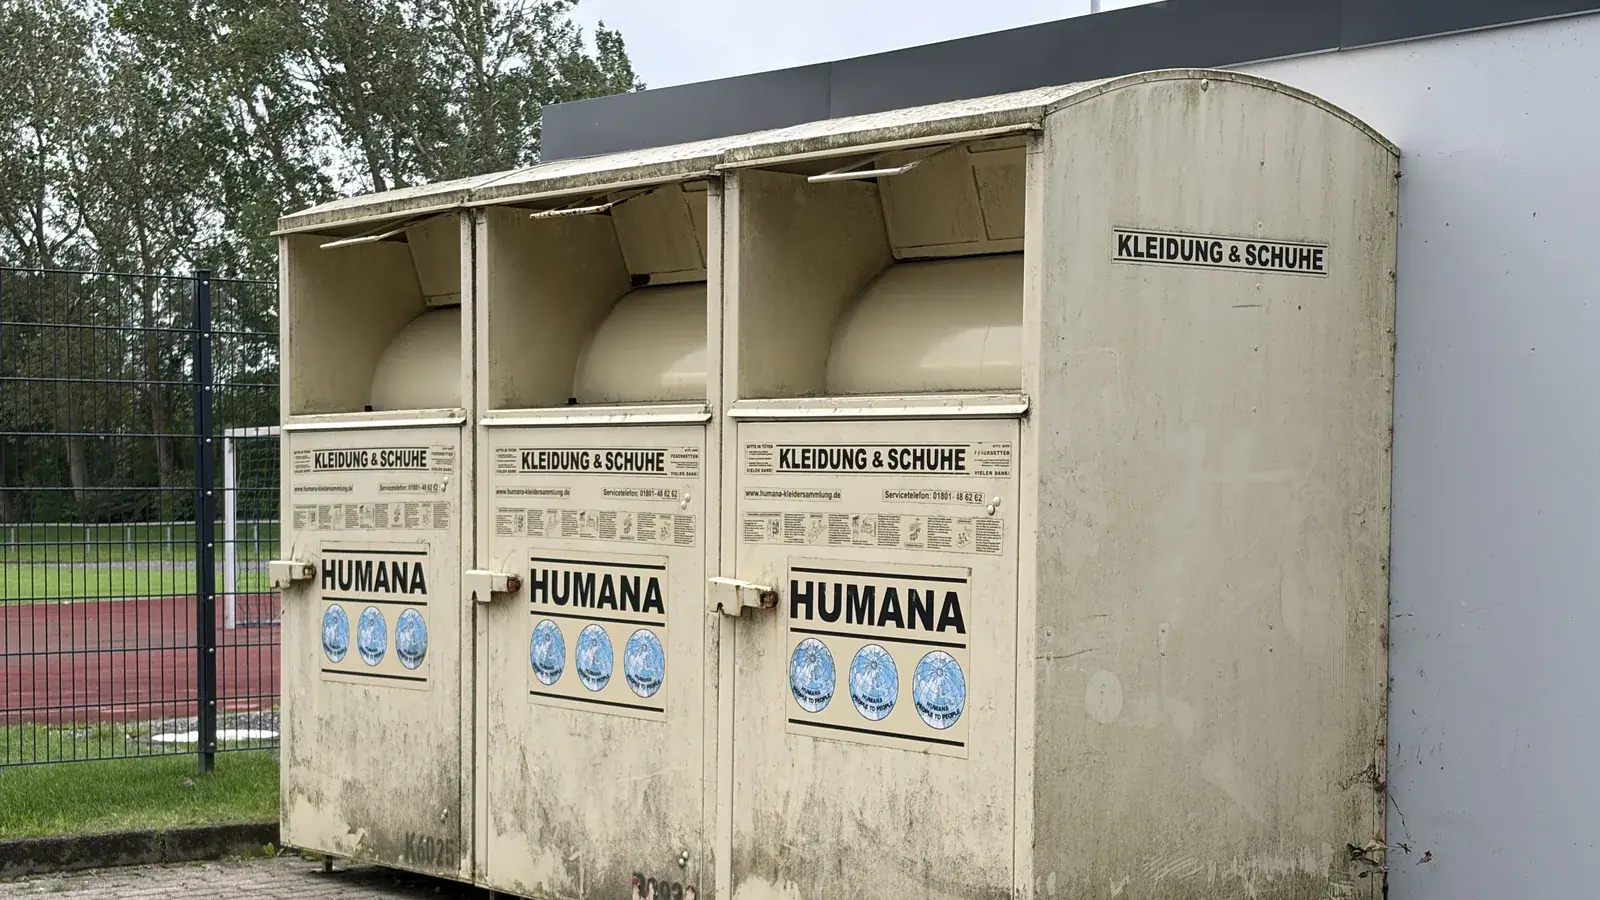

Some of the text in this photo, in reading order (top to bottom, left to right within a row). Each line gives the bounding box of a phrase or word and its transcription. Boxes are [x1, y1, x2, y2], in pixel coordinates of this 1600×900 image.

[1118, 234, 1324, 270] KLEIDUNG & SCHUHE
[314, 451, 368, 468] KLEIDUNG
[371, 453, 378, 466] &
[380, 450, 427, 468] SCHUHE
[521, 452, 589, 470] KLEIDUNG
[593, 454, 602, 469] &
[606, 452, 665, 471] SCHUHE
[779, 448, 867, 469] KLEIDUNG
[872, 450, 884, 468] &
[888, 448, 966, 471] SCHUHE
[496, 488, 570, 497] www.humana-kleidersammlung.de
[603, 489, 638, 497] Servicetelefon:
[745, 490, 840, 500] www.humana-kleidersammlung.de
[884, 490, 931, 499] Servicetelefon:
[965, 493, 972, 501] 62
[322, 559, 427, 594] HUMANA
[530, 568, 665, 614] HUMANA
[790, 579, 966, 634] HUMANA
[853, 694, 868, 709] PEOPLE
[877, 700, 893, 711] PEOPLE
[862, 694, 883, 703] HUMANA
[927, 701, 949, 711] HUMANA
[917, 701, 933, 717] PEOPLE
[942, 708, 960, 719] PEOPLE
